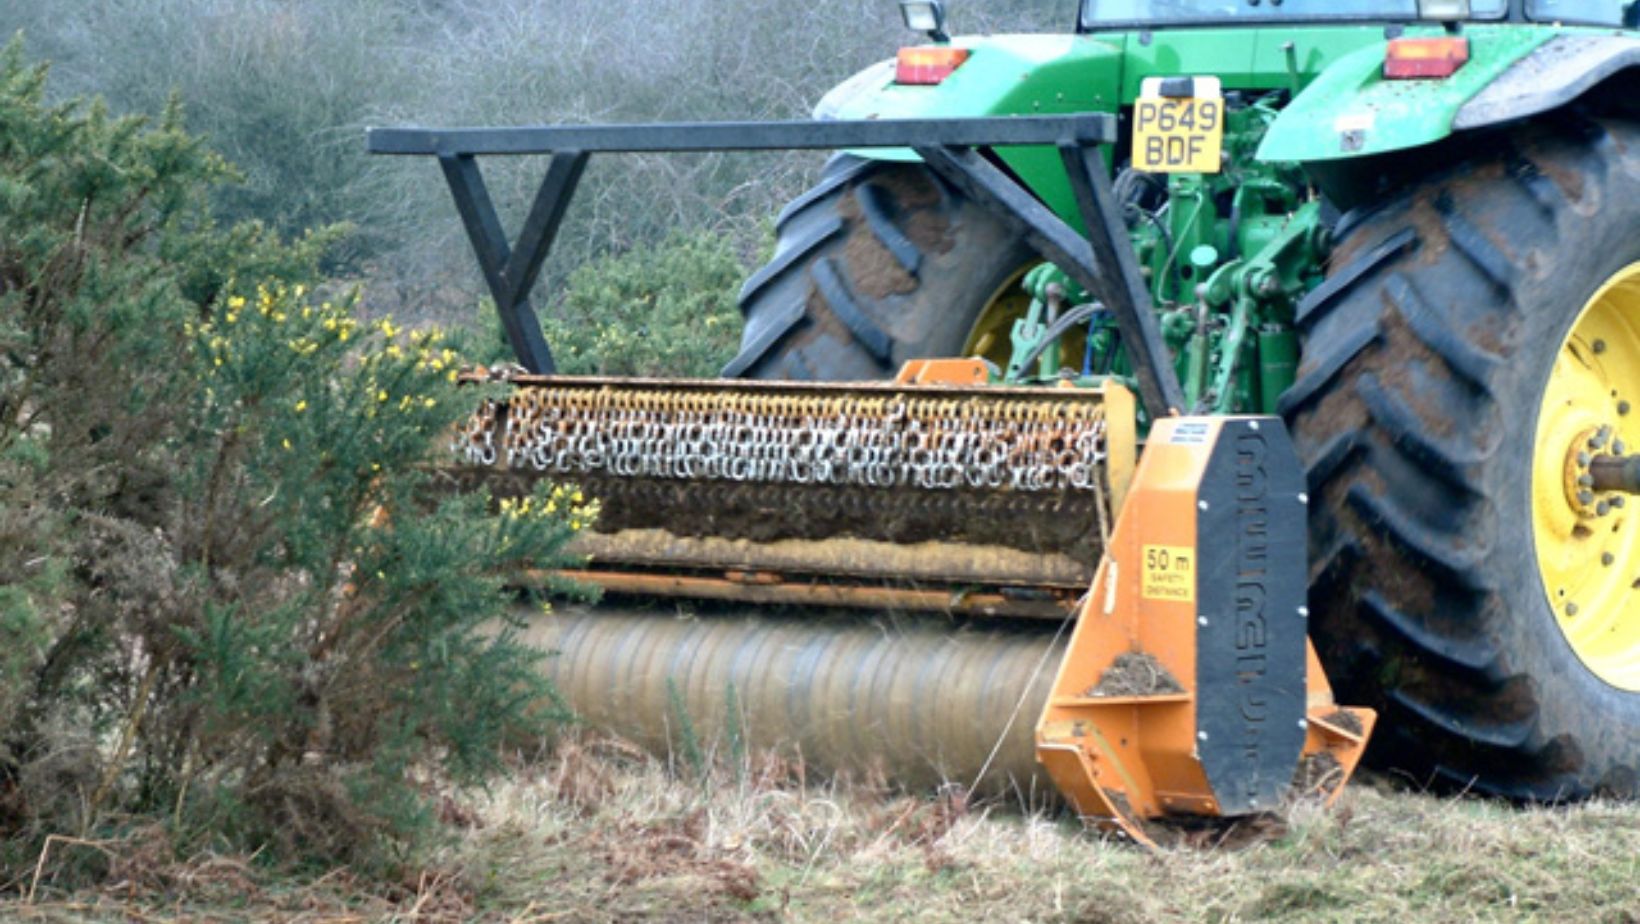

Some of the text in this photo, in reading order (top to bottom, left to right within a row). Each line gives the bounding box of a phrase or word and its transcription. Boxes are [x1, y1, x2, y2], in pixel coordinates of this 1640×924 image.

[1138, 101, 1217, 132] P649
[1145, 135, 1206, 165] BDF
[1147, 548, 1190, 571] 50 m
